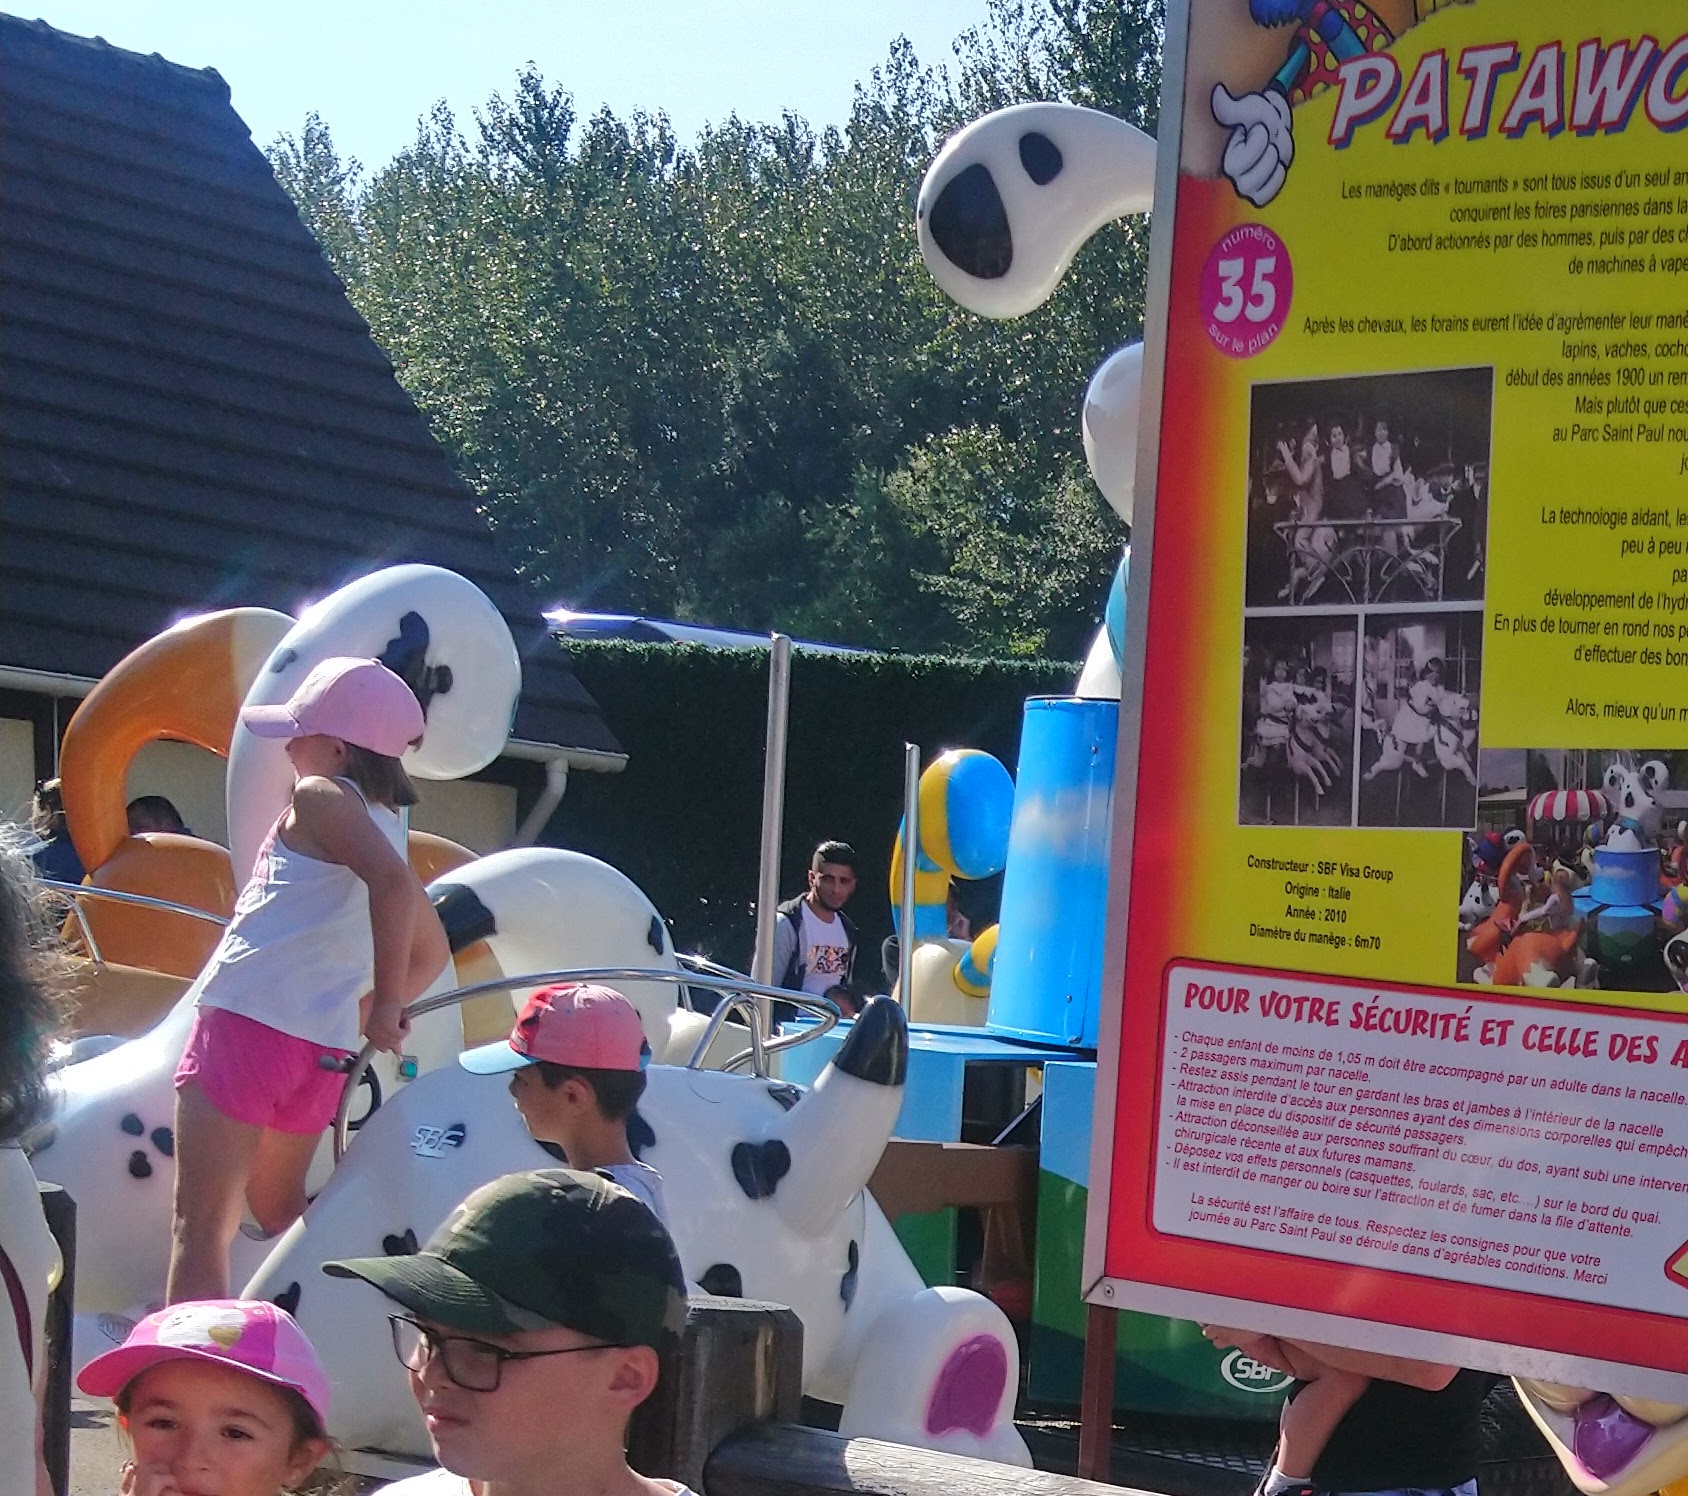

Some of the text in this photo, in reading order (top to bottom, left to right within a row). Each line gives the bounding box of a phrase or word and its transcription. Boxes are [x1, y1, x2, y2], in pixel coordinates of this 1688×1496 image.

[1342, 182, 1361, 199] Les
[1365, 181, 1417, 201] manèges
[1420, 179, 1439, 195] dits
[1455, 176, 1508, 194] tournants
[1523, 174, 1547, 192] sont
[1552, 174, 1576, 190] tous
[1581, 172, 1611, 189] issus
[1615, 170, 1640, 188] d'un
[1645, 168, 1670, 187] seul
[1222, 226, 1276, 252] numéro
[1213, 256, 1276, 323] 35
[1208, 322, 1279, 354] sur le plan
[1562, 340, 1599, 362] lapins,
[1605, 340, 1649, 358] vaches,
[1506, 368, 1538, 386] début
[1542, 369, 1563, 386] des
[1567, 368, 1610, 386] années
[1616, 367, 1645, 386] 1900
[1649, 372, 1663, 385] un
[1576, 396, 1603, 414] Mais
[1607, 396, 1640, 417] plutôt
[1644, 400, 1666, 417] que
[1553, 428, 1567, 441] au
[1572, 424, 1599, 441] Parc
[1602, 424, 1633, 442] Saint
[1637, 424, 1664, 442] Paul
[1542, 507, 1555, 523] La
[1632, 508, 1671, 528] aidant,
[1574, 645, 1637, 664] d'effectuer
[1640, 647, 1661, 665] des
[1566, 698, 1598, 718] Alors,
[1604, 702, 1639, 718] mieux
[1643, 703, 1675, 724] qu'un
[1248, 855, 1393, 884] Constructeur SBF Visa Group
[1285, 881, 1350, 900] Origine Italie
[1285, 905, 1346, 923] Année 2010
[1250, 923, 1380, 949] Diamètre du manège 6m70
[1185, 983, 1250, 1014] POUR
[1260, 991, 1340, 1027] VOTRE
[1350, 996, 1473, 1043] SÉCURITÉ
[1479, 1019, 1514, 1047] ET
[1522, 1024, 1599, 1058] CELLE
[1608, 1034, 1659, 1064] DES
[1180, 1047, 1370, 1082] 2 passagers maximum par nacelle.
[1175, 1127, 1415, 1171] chirurgicale récente et aux futures mamans.
[1191, 1193, 1600, 1266] La sécurité est l'affaire de tous. Respectez les consignes pour que votre
[1188, 1208, 1230, 1225] journée
[1233, 1218, 1247, 1227] au
[1251, 1218, 1276, 1232] Parc
[1279, 1223, 1308, 1237] Saint
[1311, 1228, 1337, 1241] Paul
[1339, 1235, 1352, 1244] se
[1356, 1236, 1398, 1251] déroule
[1402, 1243, 1430, 1257] dans
[1434, 1248, 1501, 1268] d'agréables
[1574, 1269, 1608, 1284] Merci
